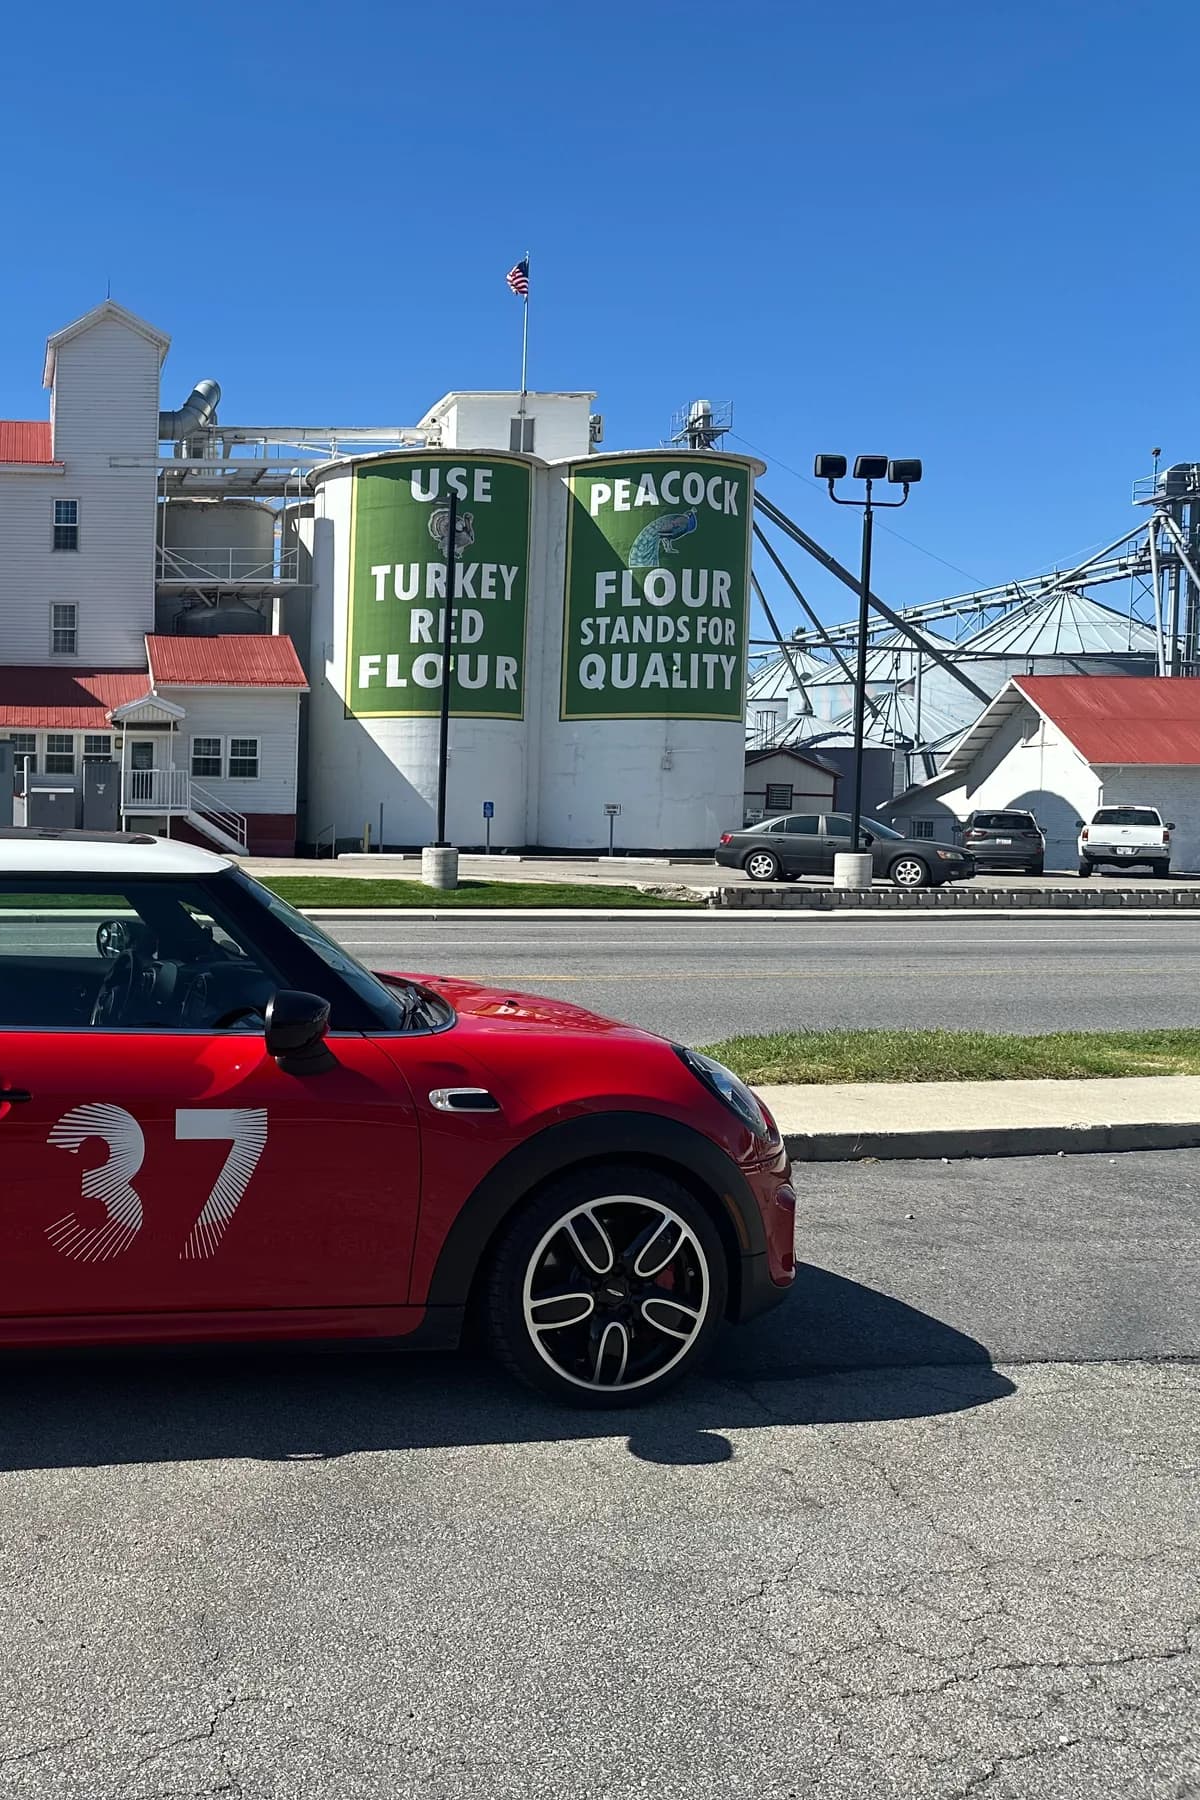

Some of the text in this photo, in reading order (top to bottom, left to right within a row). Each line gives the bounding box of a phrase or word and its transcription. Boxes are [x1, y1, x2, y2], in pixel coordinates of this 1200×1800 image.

[410, 467, 493, 502] USE
[590, 470, 739, 517] PEACOCK
[370, 562, 520, 601] TURKEY
[594, 568, 732, 609] FLOUR
[409, 608, 485, 644] RED
[580, 615, 737, 647] STANDS FOR
[358, 652, 518, 690] FLOUR
[578, 652, 737, 691] QUALITY
[43, 1102, 269, 1263] 37
